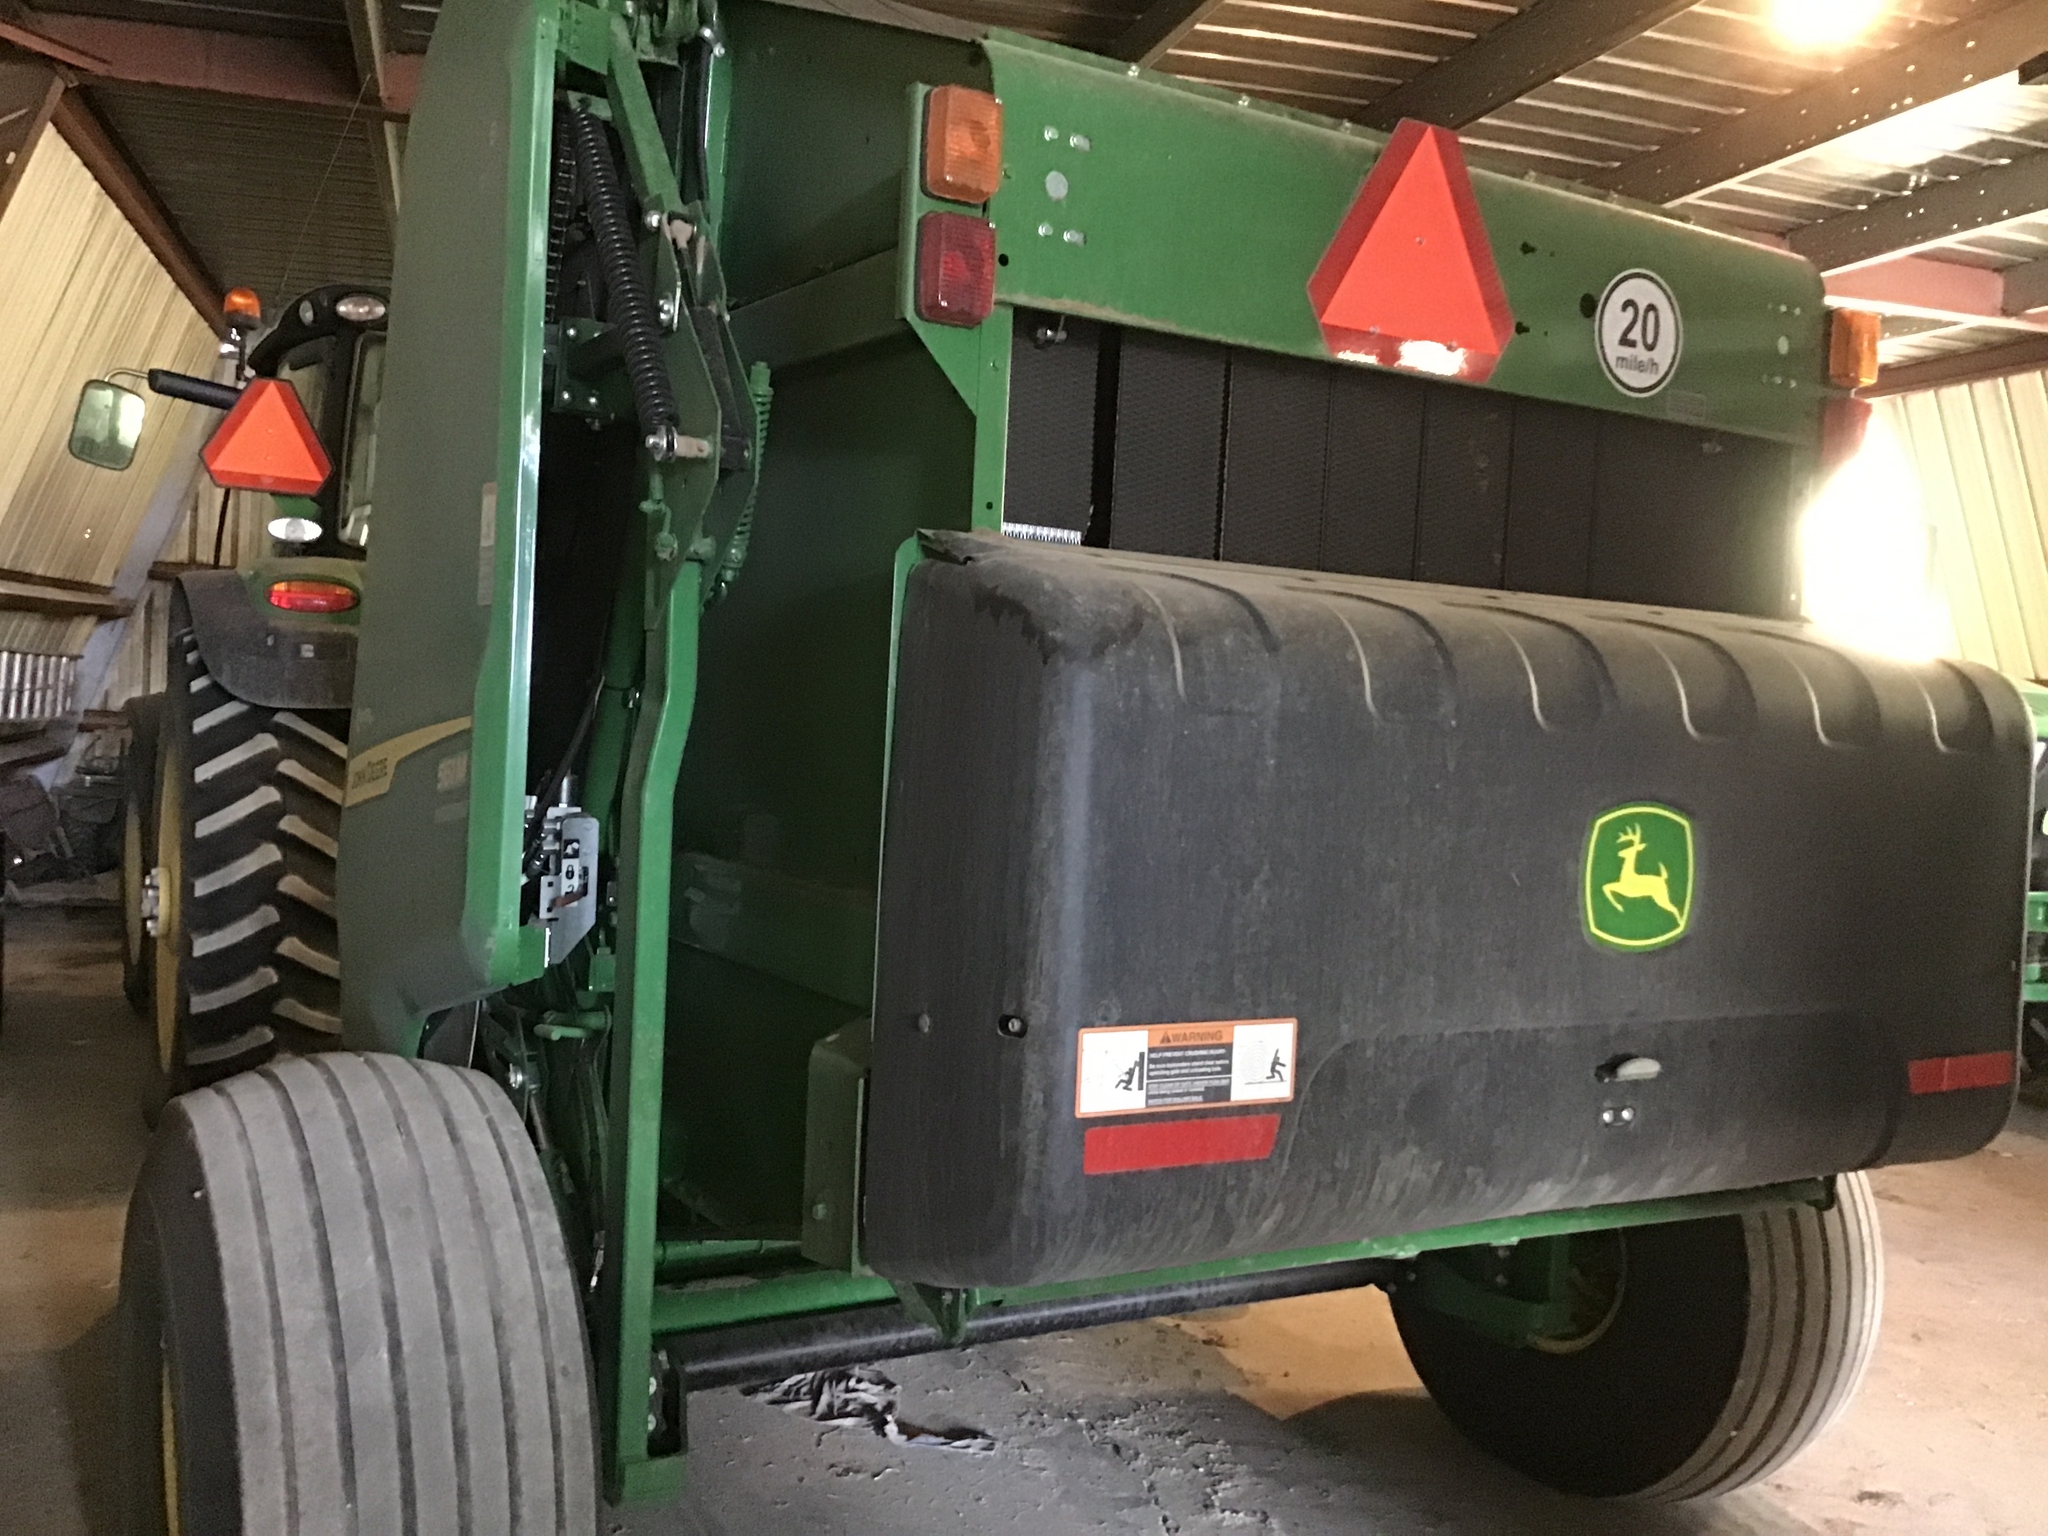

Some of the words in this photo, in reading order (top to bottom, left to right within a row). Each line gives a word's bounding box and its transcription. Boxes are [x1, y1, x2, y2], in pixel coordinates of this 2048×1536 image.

[1618, 298, 1660, 352] 20
[1615, 354, 1660, 375] mile/h
[1171, 1030, 1223, 1042] WARNING
